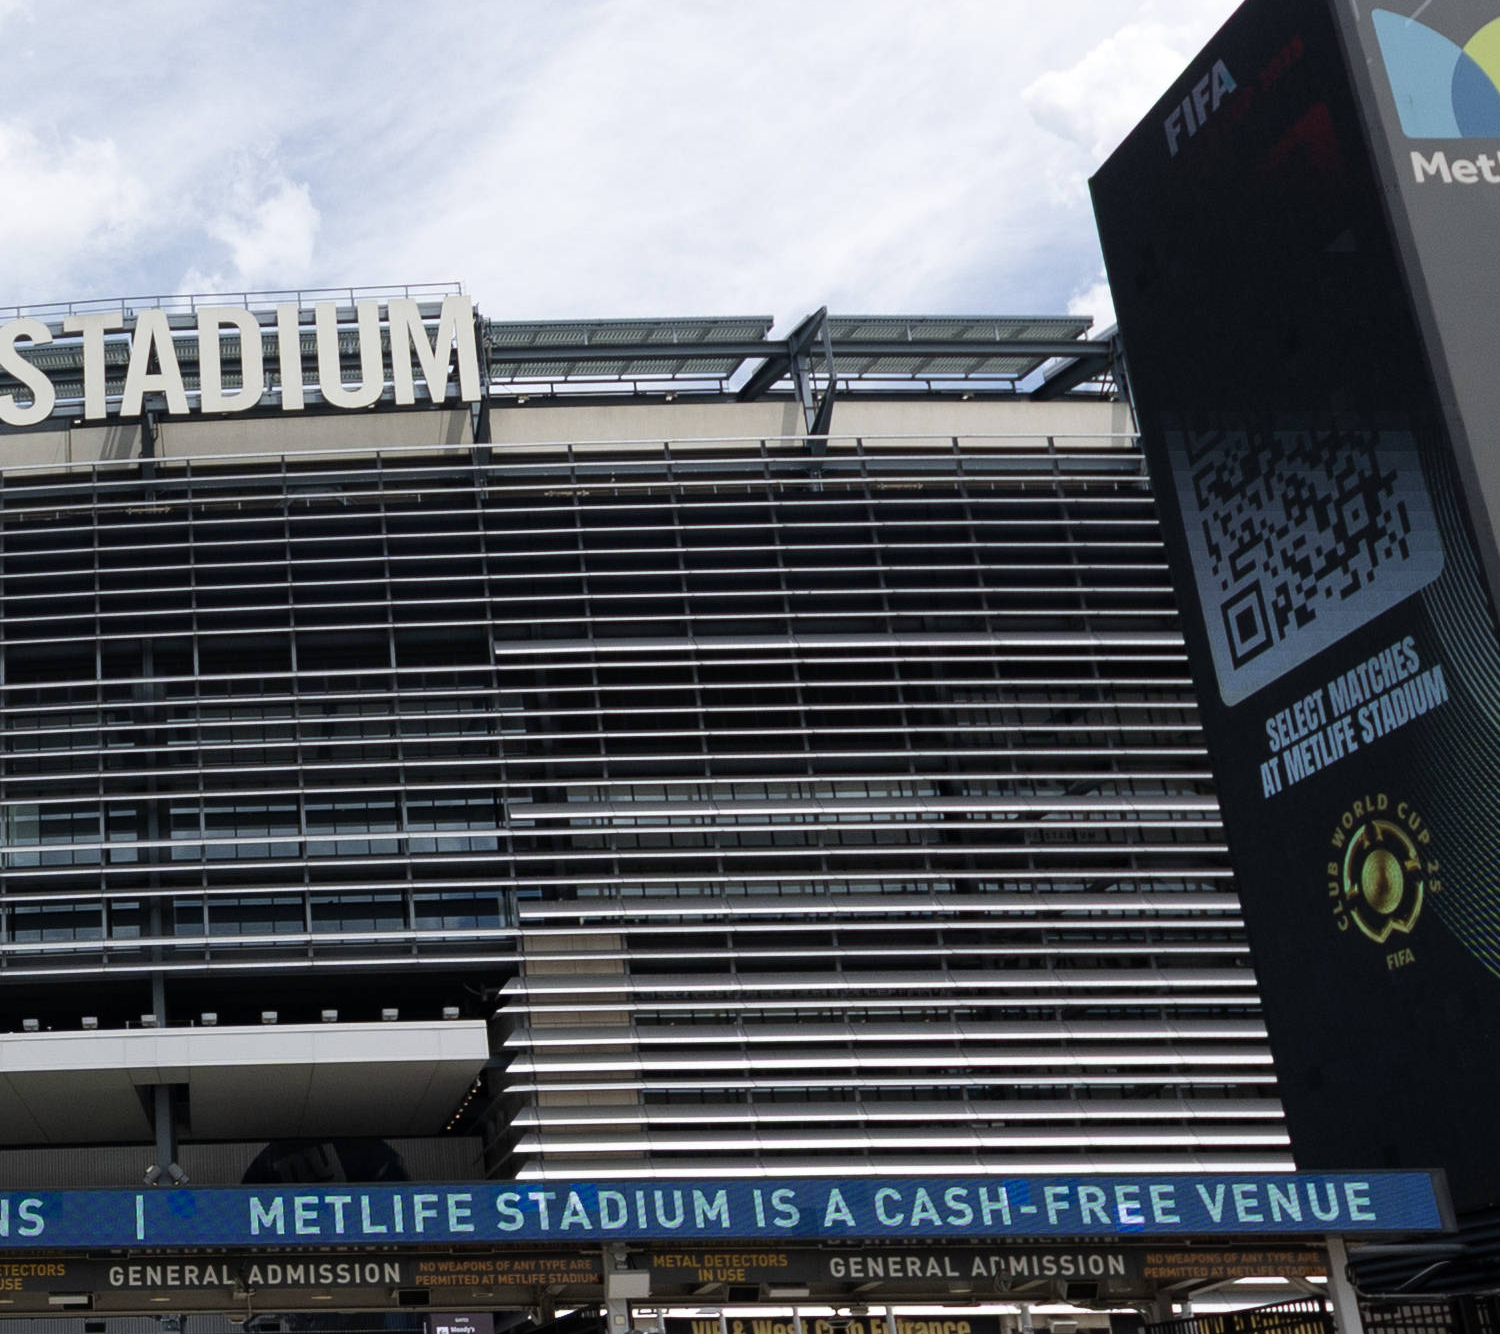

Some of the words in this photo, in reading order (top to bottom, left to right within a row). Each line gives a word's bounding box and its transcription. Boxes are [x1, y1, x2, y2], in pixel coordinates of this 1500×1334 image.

[1163, 59, 1237, 157] FIFA
[1265, 689, 1326, 753] SELECT
[1327, 636, 1420, 718] MATCHES
[1260, 761, 1282, 799] AT
[1283, 715, 1359, 787] METLIFE
[1357, 665, 1449, 745] STADIUM
[1332, 793, 1388, 849] WORLD
[1397, 803, 1430, 845] CUP
[1327, 862, 1348, 931] CLUB
[1386, 948, 1415, 970] FIFA
[250, 1193, 475, 1235] METLIFE
[497, 1188, 731, 1231] STADIUM
[753, 1188, 800, 1229] IS
[823, 1188, 856, 1228] A
[874, 1184, 1180, 1227] CASH-FREE
[1197, 1181, 1377, 1223] VENUE
[420, 1262, 436, 1272] NO
[437, 1261, 493, 1271] WEAPONS
[496, 1261, 510, 1271] OF
[514, 1260, 536, 1271] ANY
[539, 1260, 566, 1270] TYPE
[569, 1259, 592, 1270] ARE
[653, 1255, 700, 1267] METAL
[702, 1254, 788, 1266] DETECTORS
[830, 1256, 959, 1278] GENERAL
[971, 1254, 1126, 1278] ADMISSION
[109, 1265, 236, 1286] GENERAL
[248, 1262, 401, 1285] ADMISSION
[415, 1275, 479, 1285] PERMITTED
[481, 1275, 495, 1284] AT
[499, 1274, 546, 1284] METLIFE
[548, 1273, 599, 1283] STADIUM
[699, 1269, 714, 1282] IN
[717, 1269, 746, 1282] USE
[450, 1326, 475, 1334] Moody's
